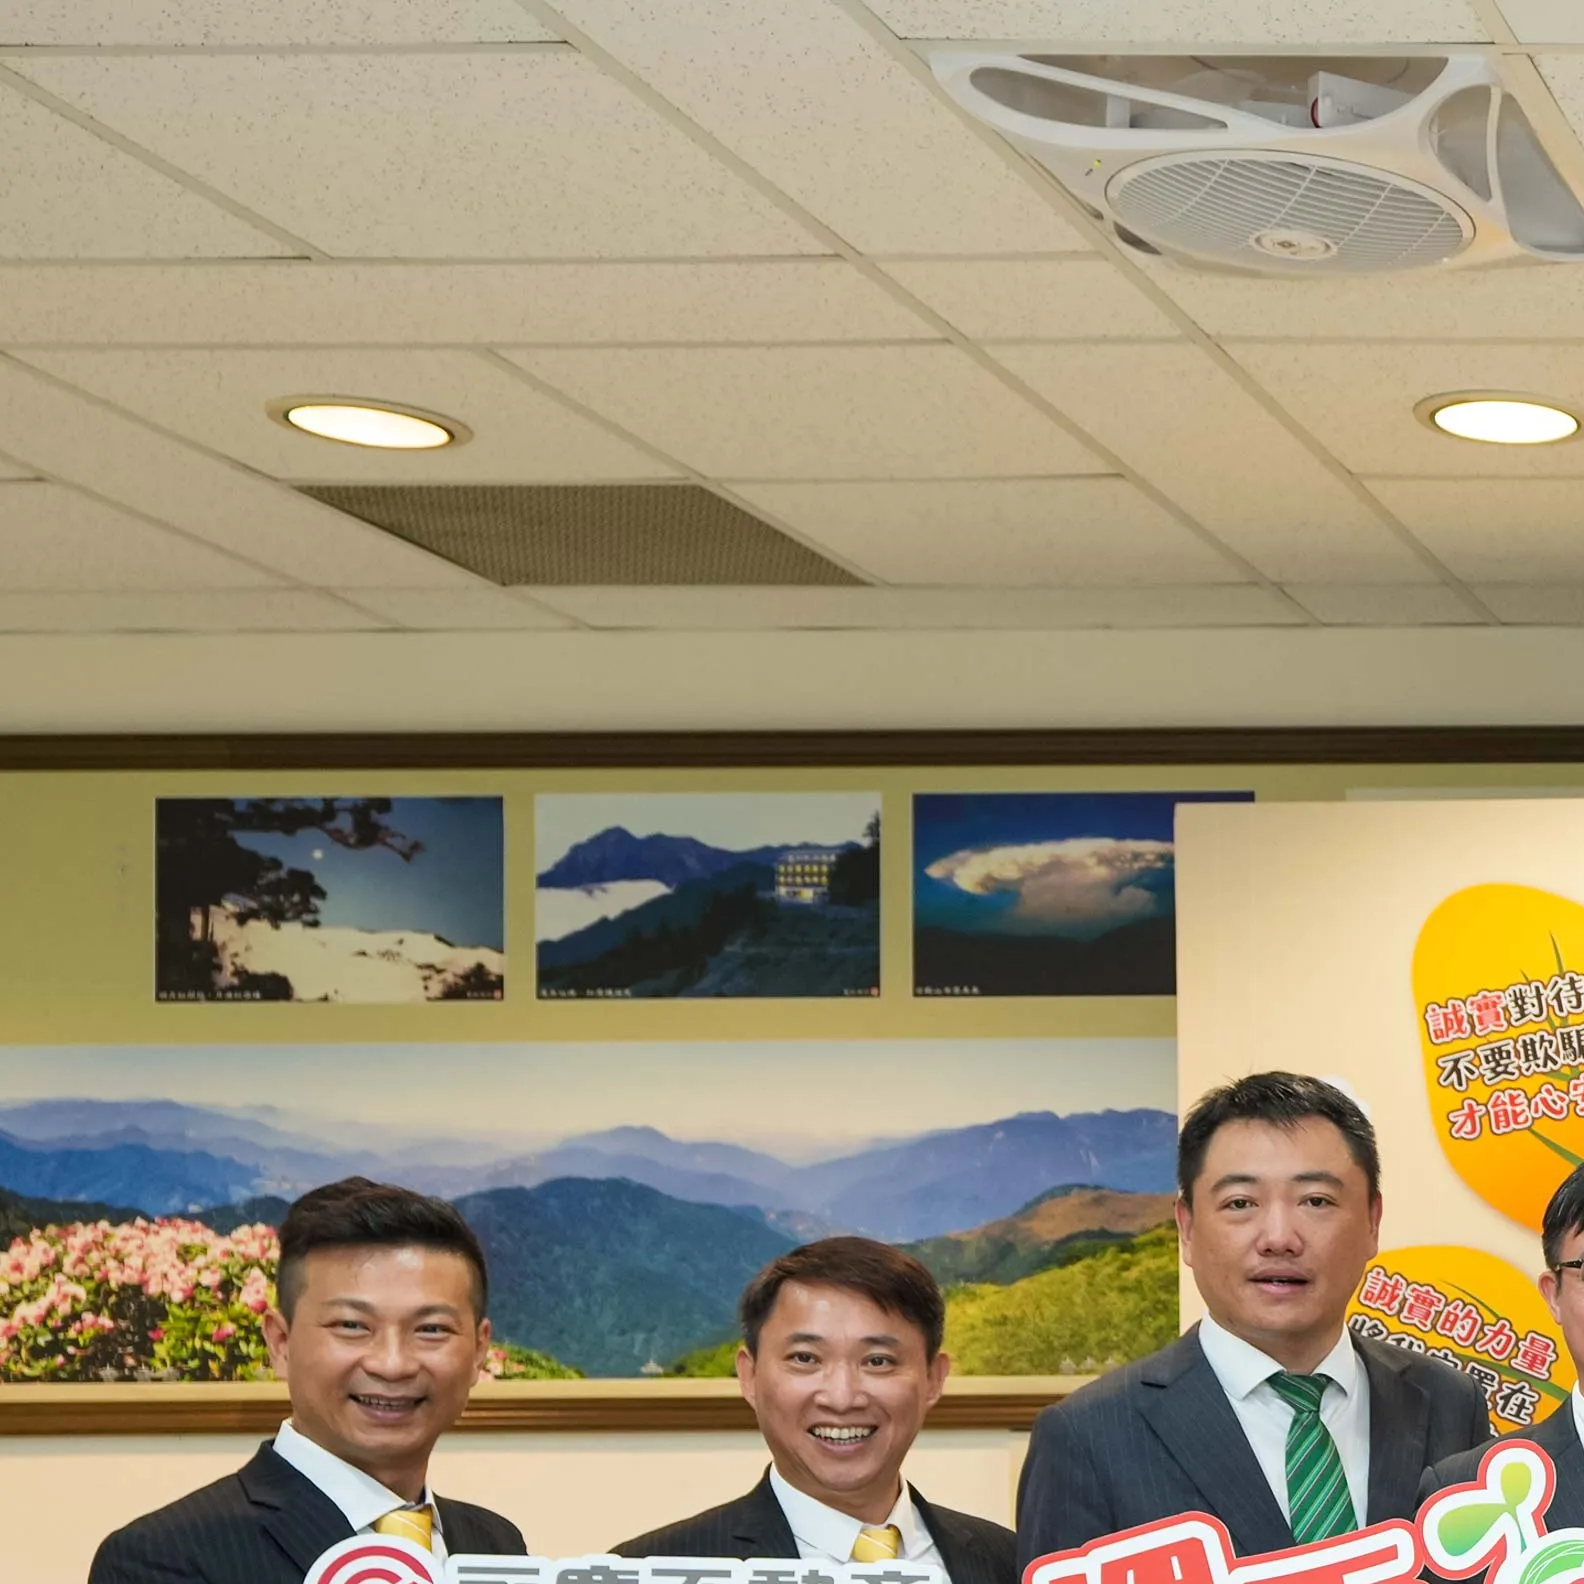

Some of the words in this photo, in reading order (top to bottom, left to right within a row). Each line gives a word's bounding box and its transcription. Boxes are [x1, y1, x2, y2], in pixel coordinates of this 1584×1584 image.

[1361, 1268, 1558, 1378] 誠實的力量
